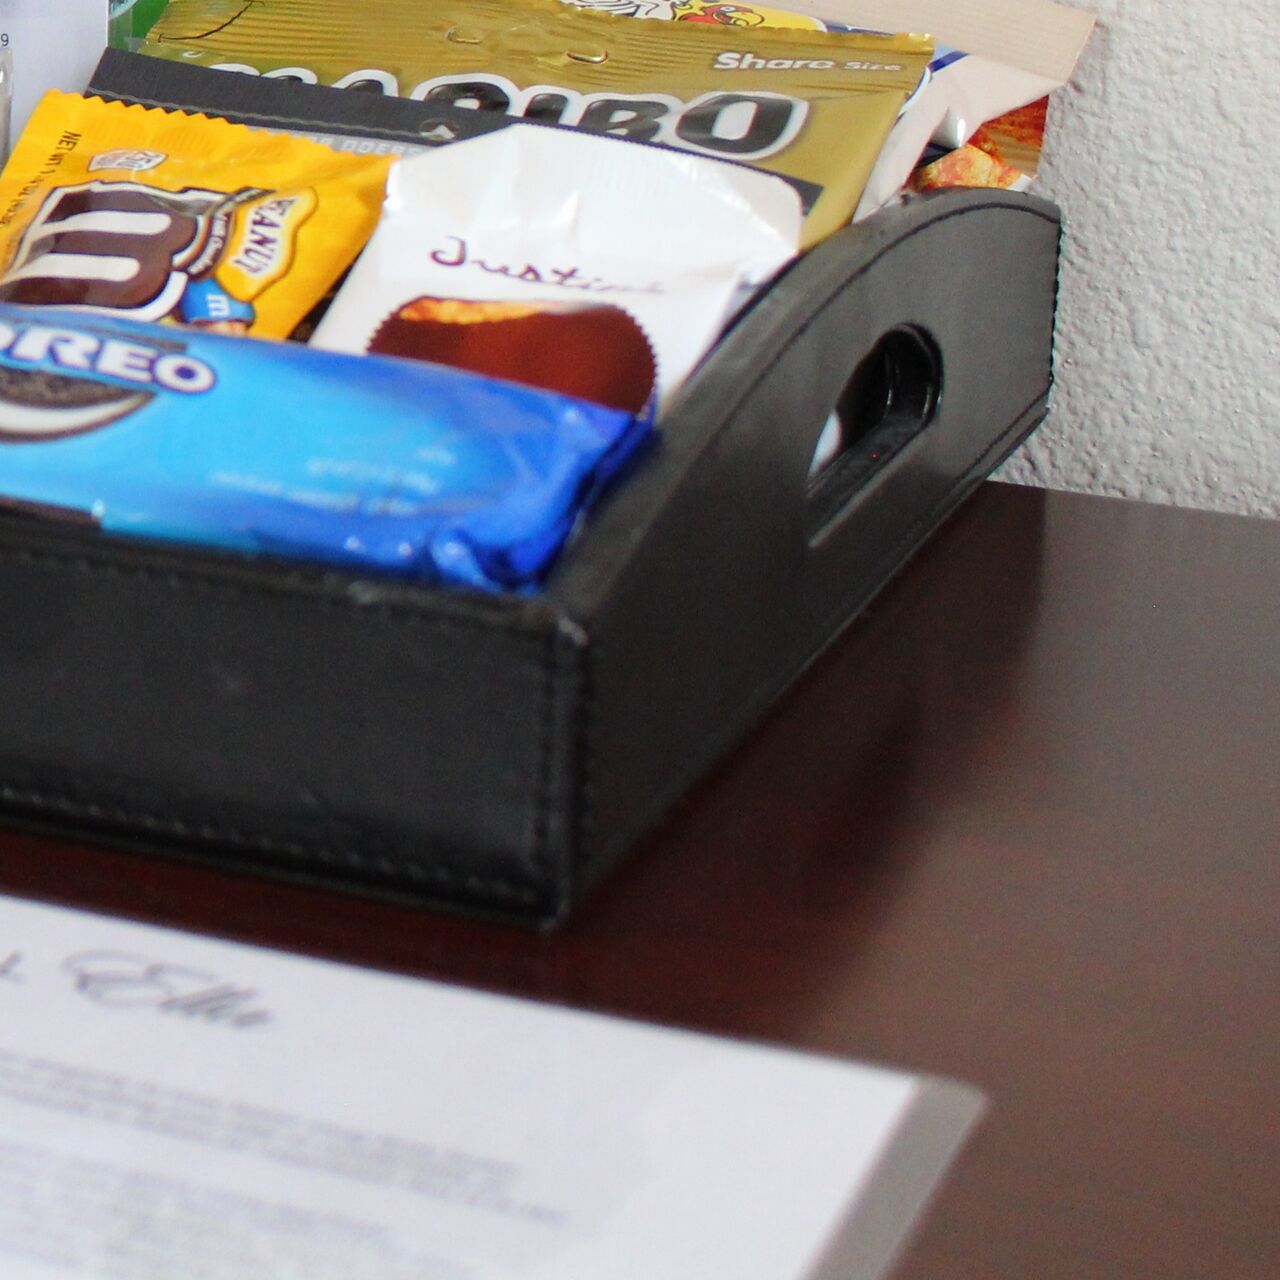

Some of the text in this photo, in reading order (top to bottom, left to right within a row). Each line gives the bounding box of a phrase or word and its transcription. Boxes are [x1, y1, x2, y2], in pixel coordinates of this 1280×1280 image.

[0, 32, 10, 47] 9
[713, 51, 903, 72] Share Size
[55, 130, 83, 152] NET
[233, 198, 297, 274] PEANUT
[205, 294, 230, 317] m
[62, 949, 276, 1031] Ella
